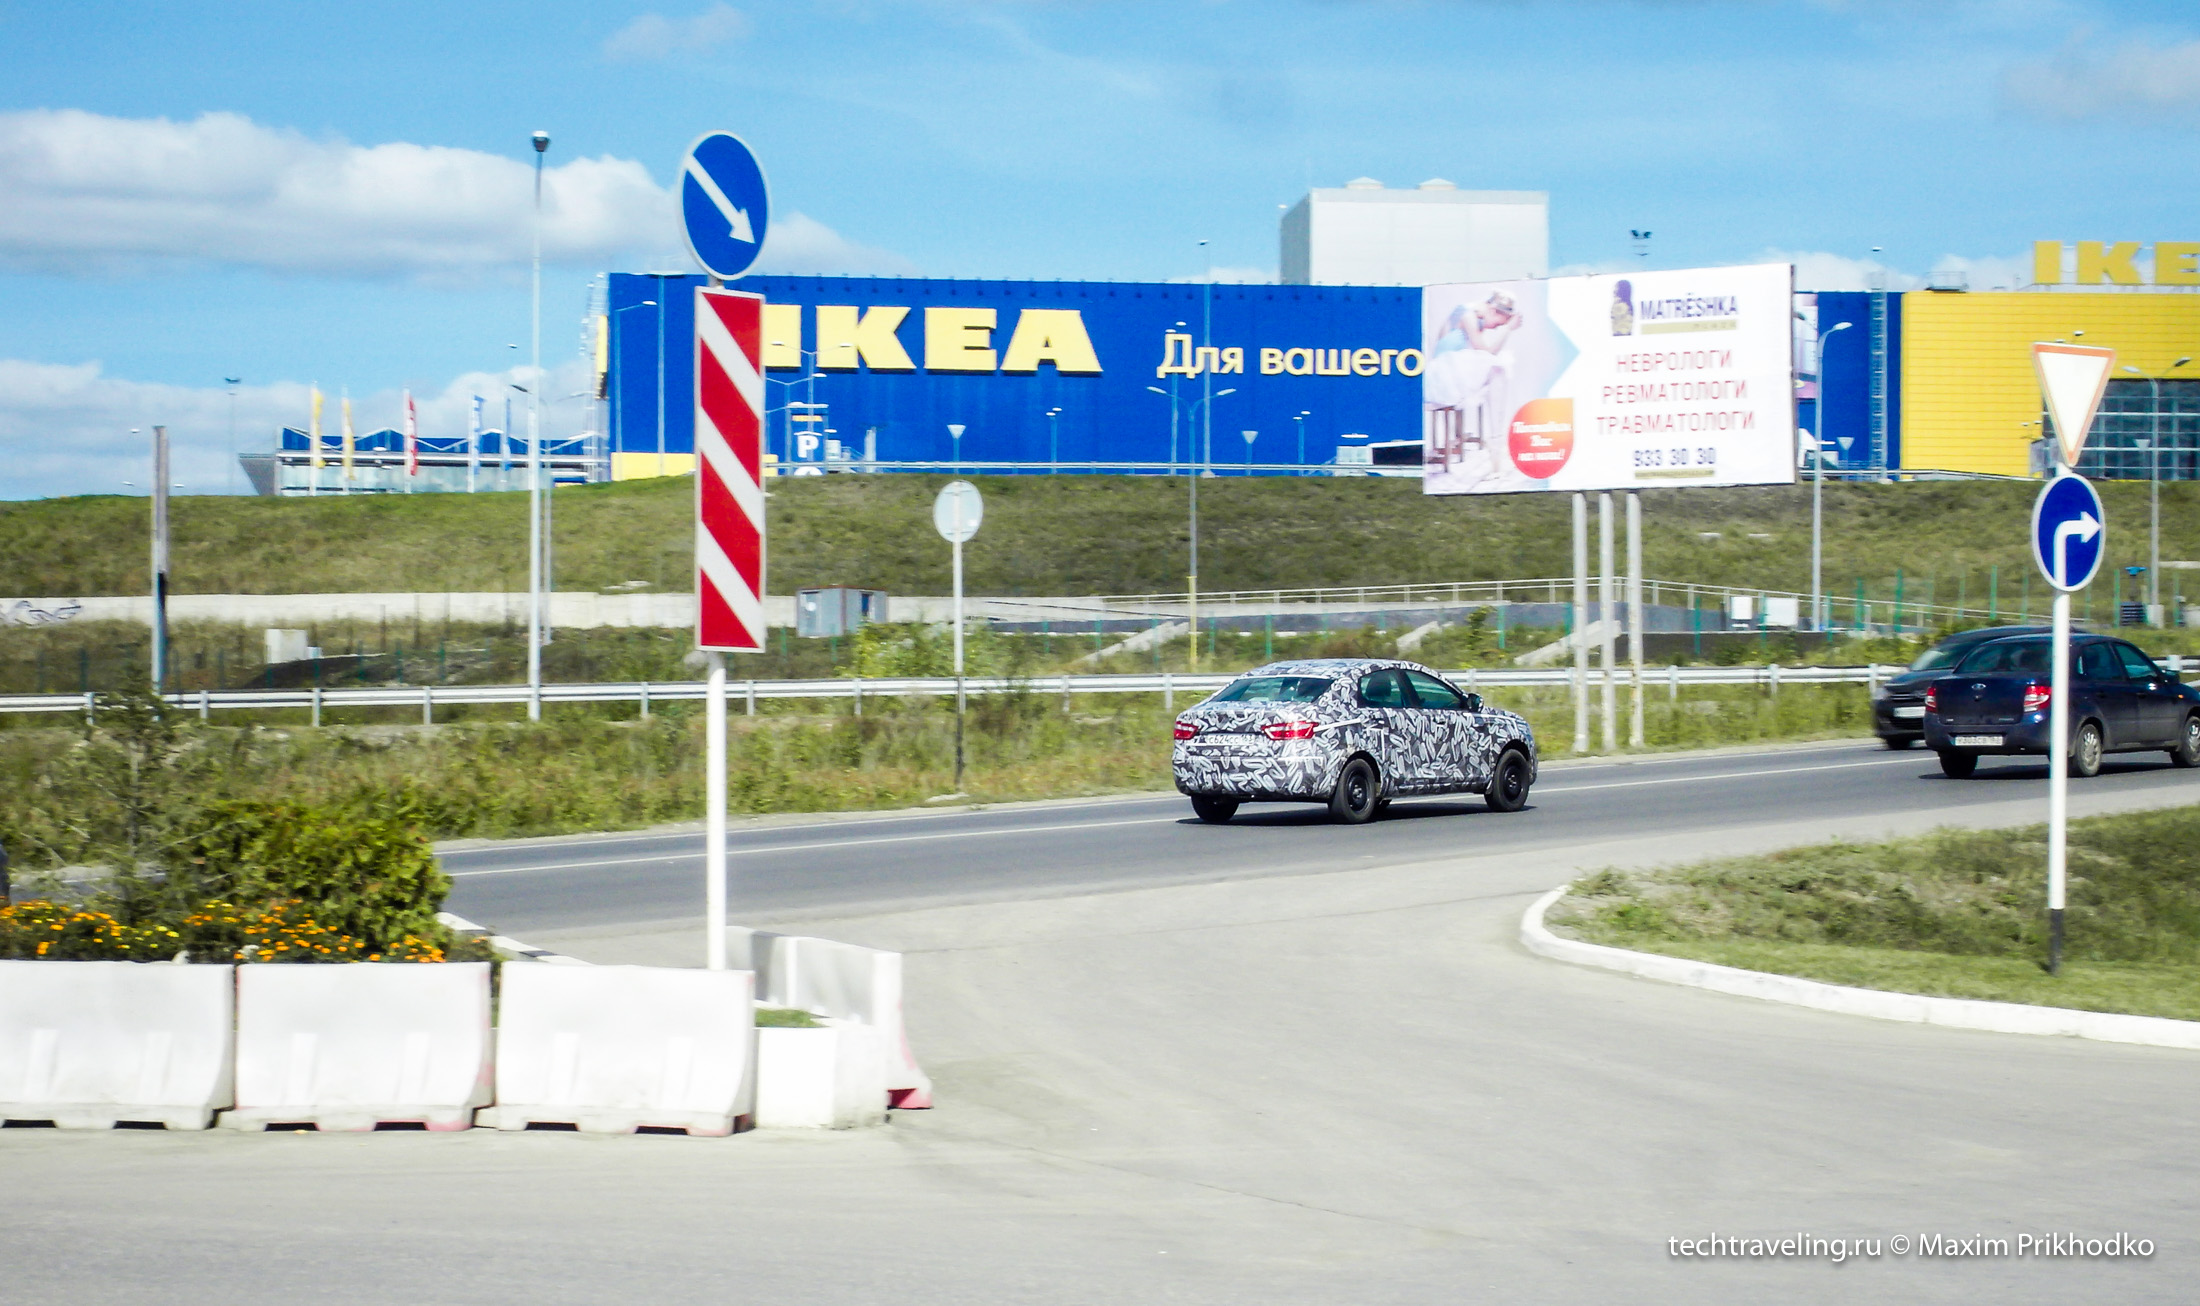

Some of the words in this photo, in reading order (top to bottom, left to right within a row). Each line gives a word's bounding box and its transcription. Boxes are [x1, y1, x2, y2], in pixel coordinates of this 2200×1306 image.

[764, 304, 1103, 374] IKEA
[1157, 333, 1244, 380] Для
[1260, 345, 1424, 378] вашего
[1617, 351, 1731, 373] НЕВРОЛОГИ
[1603, 382, 1747, 403] РЕВМАТОЛОГИ
[1597, 412, 1755, 434] ТРАВМАТОЛОГИ
[1633, 448, 1662, 467] 933
[1670, 448, 1689, 467] 30
[1697, 446, 1717, 466] 30
